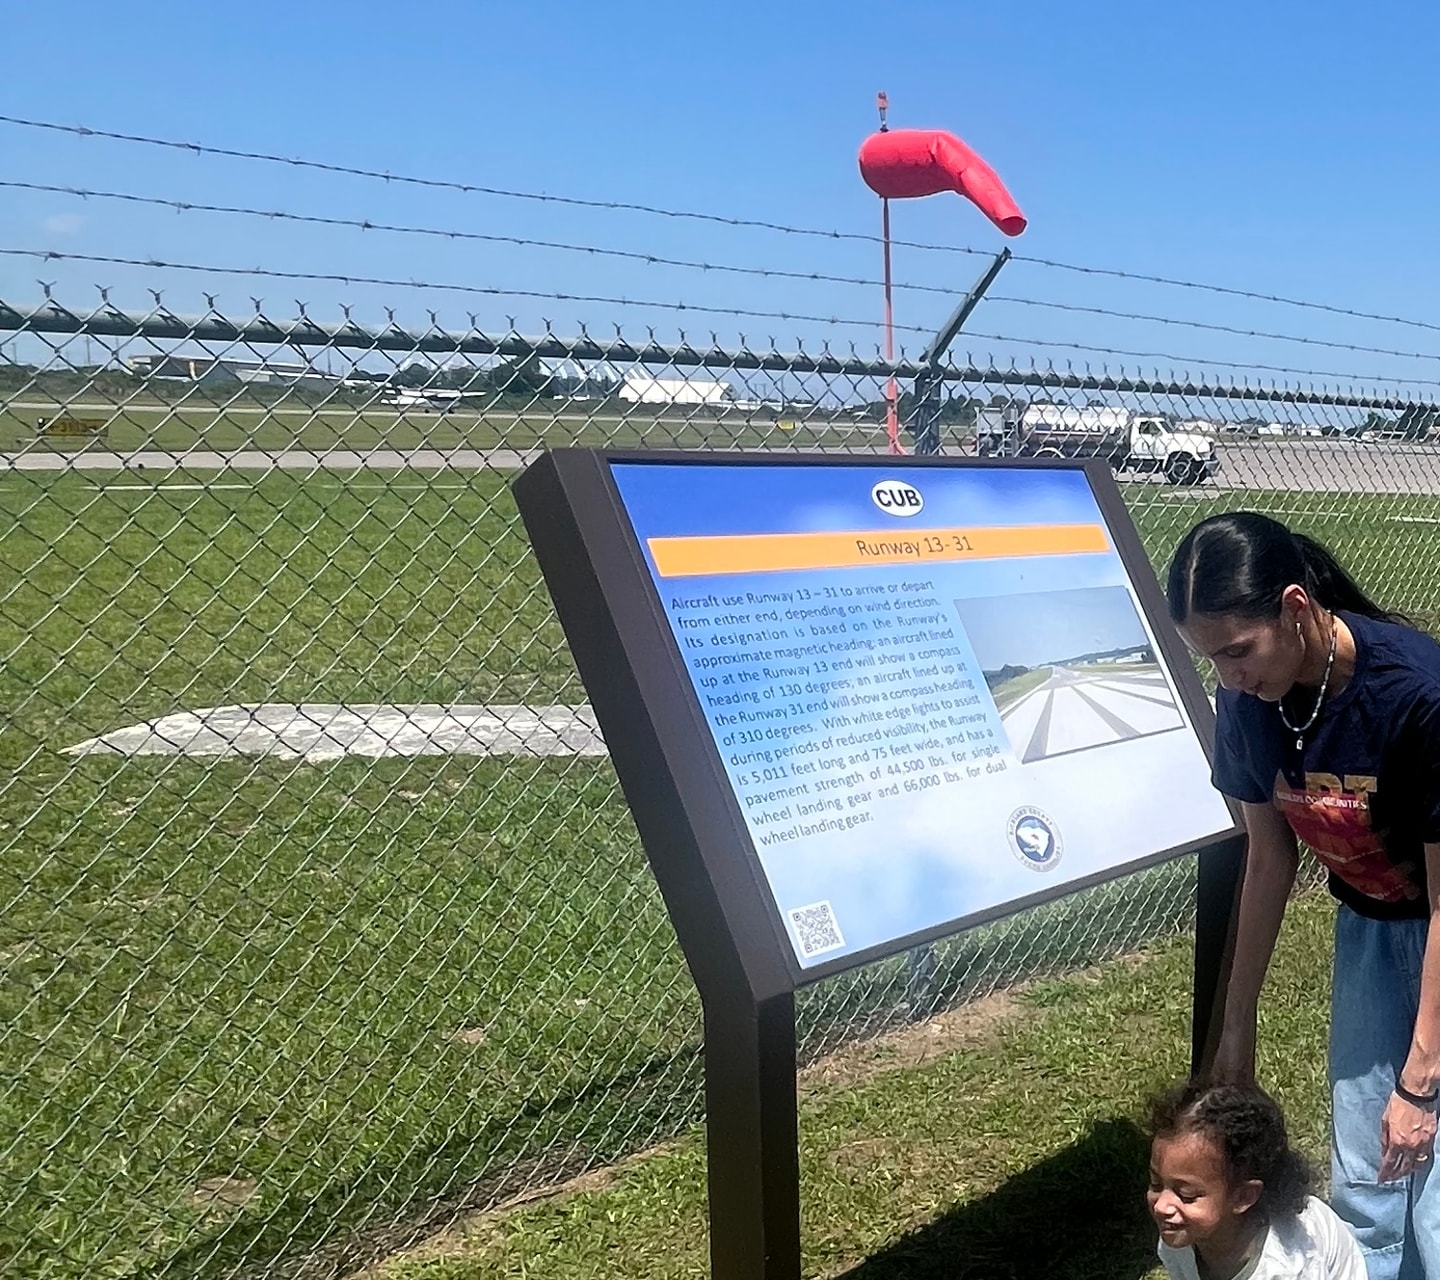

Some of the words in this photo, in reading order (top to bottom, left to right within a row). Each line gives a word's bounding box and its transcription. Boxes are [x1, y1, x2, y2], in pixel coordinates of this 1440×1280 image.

[876, 489, 921, 507] CUB
[856, 539, 920, 557] Runway
[952, 535, 974, 552] 31
[671, 595, 720, 610] Aircraft
[721, 596, 744, 606] use
[746, 592, 793, 604] Runway
[796, 588, 811, 600] 13
[823, 586, 838, 598] 31
[839, 587, 853, 596] to
[854, 585, 885, 595] arrive
[887, 585, 898, 593] or
[900, 580, 934, 592] depart
[677, 616, 711, 629] from
[714, 613, 750, 626] either
[755, 609, 782, 622] end,
[784, 605, 846, 621] depending
[847, 605, 862, 614] on
[864, 600, 891, 612] wind
[893, 598, 941, 610] direction.
[684, 637, 704, 648] Its
[710, 630, 788, 646] designation
[793, 627, 805, 637] is
[809, 622, 847, 636] based
[852, 622, 867, 632] on
[872, 618, 892, 629] the
[896, 612, 948, 626] Runway's
[693, 650, 772, 670] approximate
[773, 643, 828, 659] magnetic
[877, 638, 891, 646] an
[892, 631, 929, 645] aircraft
[927, 628, 954, 640] lined
[699, 676, 718, 689] up
[722, 673, 735, 685] at
[737, 670, 760, 683] the
[762, 666, 810, 679] Runway
[813, 660, 828, 673] 13
[831, 657, 853, 671] end
[854, 655, 875, 667] will
[877, 653, 905, 665] show
[908, 652, 916, 661] a
[917, 647, 961, 660] compass
[705, 691, 760, 707] heading
[762, 685, 775, 699] of
[779, 683, 802, 697] 130
[856, 676, 871, 686] an
[873, 668, 912, 683] aircraft
[912, 664, 939, 677] lined
[940, 665, 955, 675] up
[956, 662, 968, 672] at
[714, 713, 737, 726] the
[738, 708, 787, 723] Runway
[788, 702, 805, 715] 31
[806, 698, 829, 712] end
[829, 695, 850, 709] will
[850, 693, 880, 706] show
[881, 692, 888, 701] a
[889, 686, 934, 700] compass
[932, 679, 975, 692] heading
[722, 732, 736, 746] of
[738, 729, 763, 744] 310
[765, 723, 817, 740] degrees.
[821, 715, 851, 729] With
[851, 711, 884, 724] white
[885, 706, 911, 720] edge
[911, 701, 941, 716] lights
[940, 700, 953, 709] to
[953, 694, 981, 708] assist
[730, 750, 773, 766] during
[773, 740, 820, 761] periods
[821, 736, 833, 750] of
[835, 728, 882, 747] reduced
[882, 722, 929, 738] visibility,
[928, 718, 947, 730] the
[947, 712, 986, 726] Runway
[736, 774, 749, 786] is
[751, 766, 788, 783] 5,011
[790, 762, 817, 775] feet
[817, 757, 847, 770] long
[848, 749, 870, 765] and
[871, 746, 887, 759] 75
[889, 743, 913, 756] feet
[913, 738, 944, 751] wide,
[945, 732, 965, 746] and
[965, 730, 985, 741] has
[986, 729, 993, 737] a
[744, 783, 809, 809] pavement
[814, 771, 864, 792] strength
[869, 766, 881, 780] of
[887, 758, 925, 775] 44,500
[927, 755, 947, 767] lbs.
[951, 751, 966, 762] for
[971, 744, 1000, 759] single
[751, 806, 792, 825] wheel
[796, 798, 843, 816] landing
[847, 791, 872, 807] gear
[877, 782, 899, 798] and
[903, 774, 940, 792] 66,000
[942, 771, 963, 782] lbs.
[965, 766, 980, 778] for
[985, 759, 1007, 774] dual
[759, 825, 799, 845] wheel
[798, 818, 846, 836] landing
[845, 811, 873, 829] gear.
